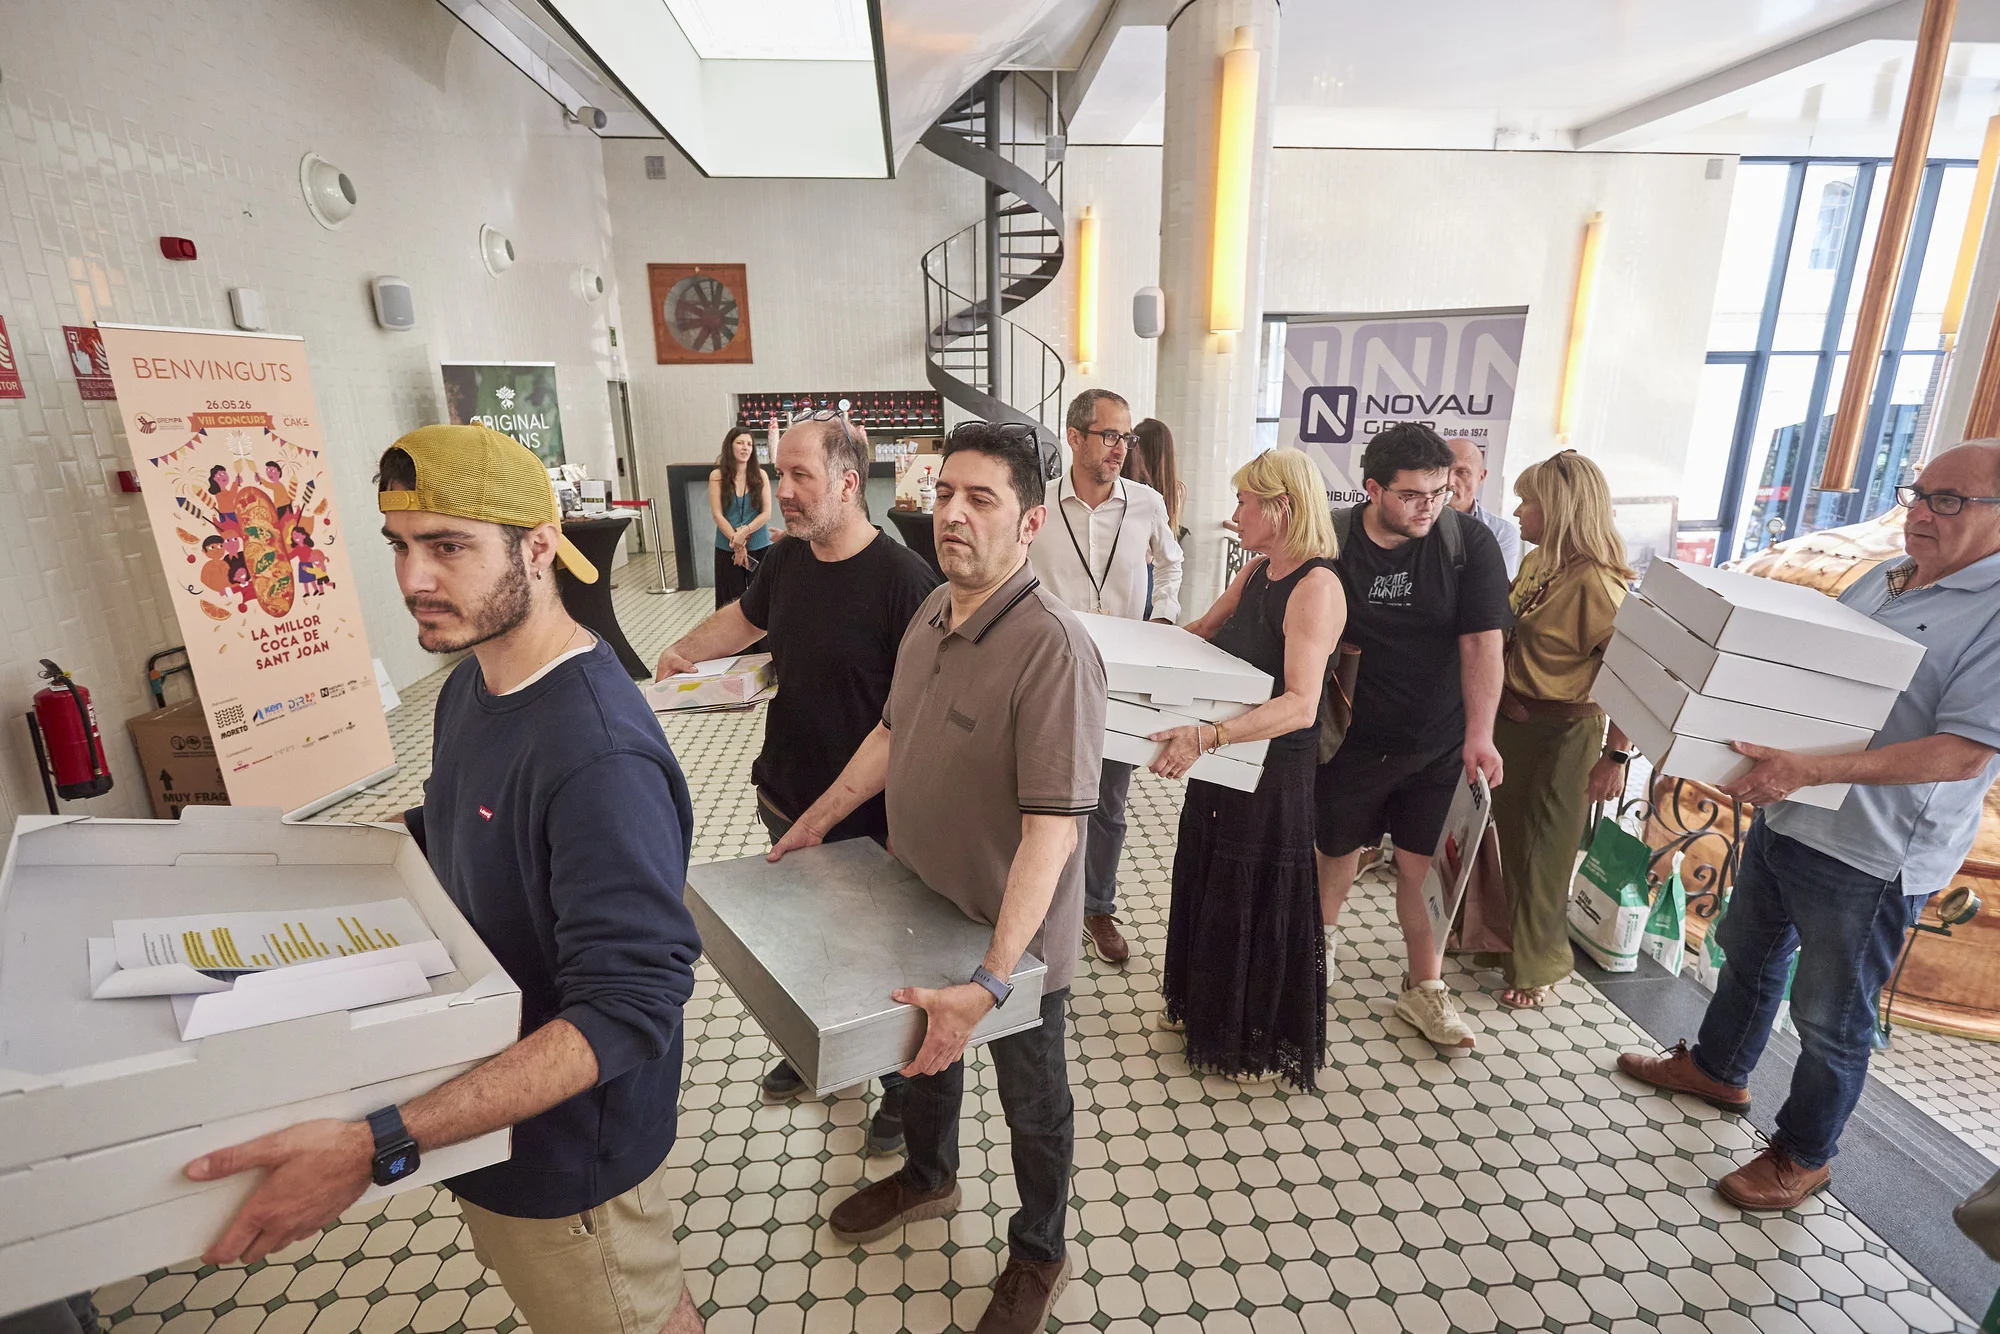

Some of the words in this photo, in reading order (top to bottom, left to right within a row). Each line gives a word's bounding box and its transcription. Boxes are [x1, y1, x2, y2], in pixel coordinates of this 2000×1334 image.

[132, 357, 292, 382] BENVINGUTS
[206, 400, 252, 410] 26.05.26
[1366, 394, 1494, 416] NOVAU
[197, 415, 215, 425] VIII
[218, 415, 266, 425] CONCURS
[1443, 427, 1457, 437] Des
[1459, 427, 1469, 437] de
[1471, 427, 1488, 437] 1974
[1374, 571, 1408, 588] PIRATE
[1368, 582, 1412, 599] HUNTER
[251, 627, 270, 641] LA
[274, 614, 321, 635] MILLOR
[260, 635, 299, 653] COCA
[303, 629, 319, 642] DE
[256, 651, 290, 670] SANT
[296, 640, 330, 659] JOAN
[162, 793, 190, 802] MUY
